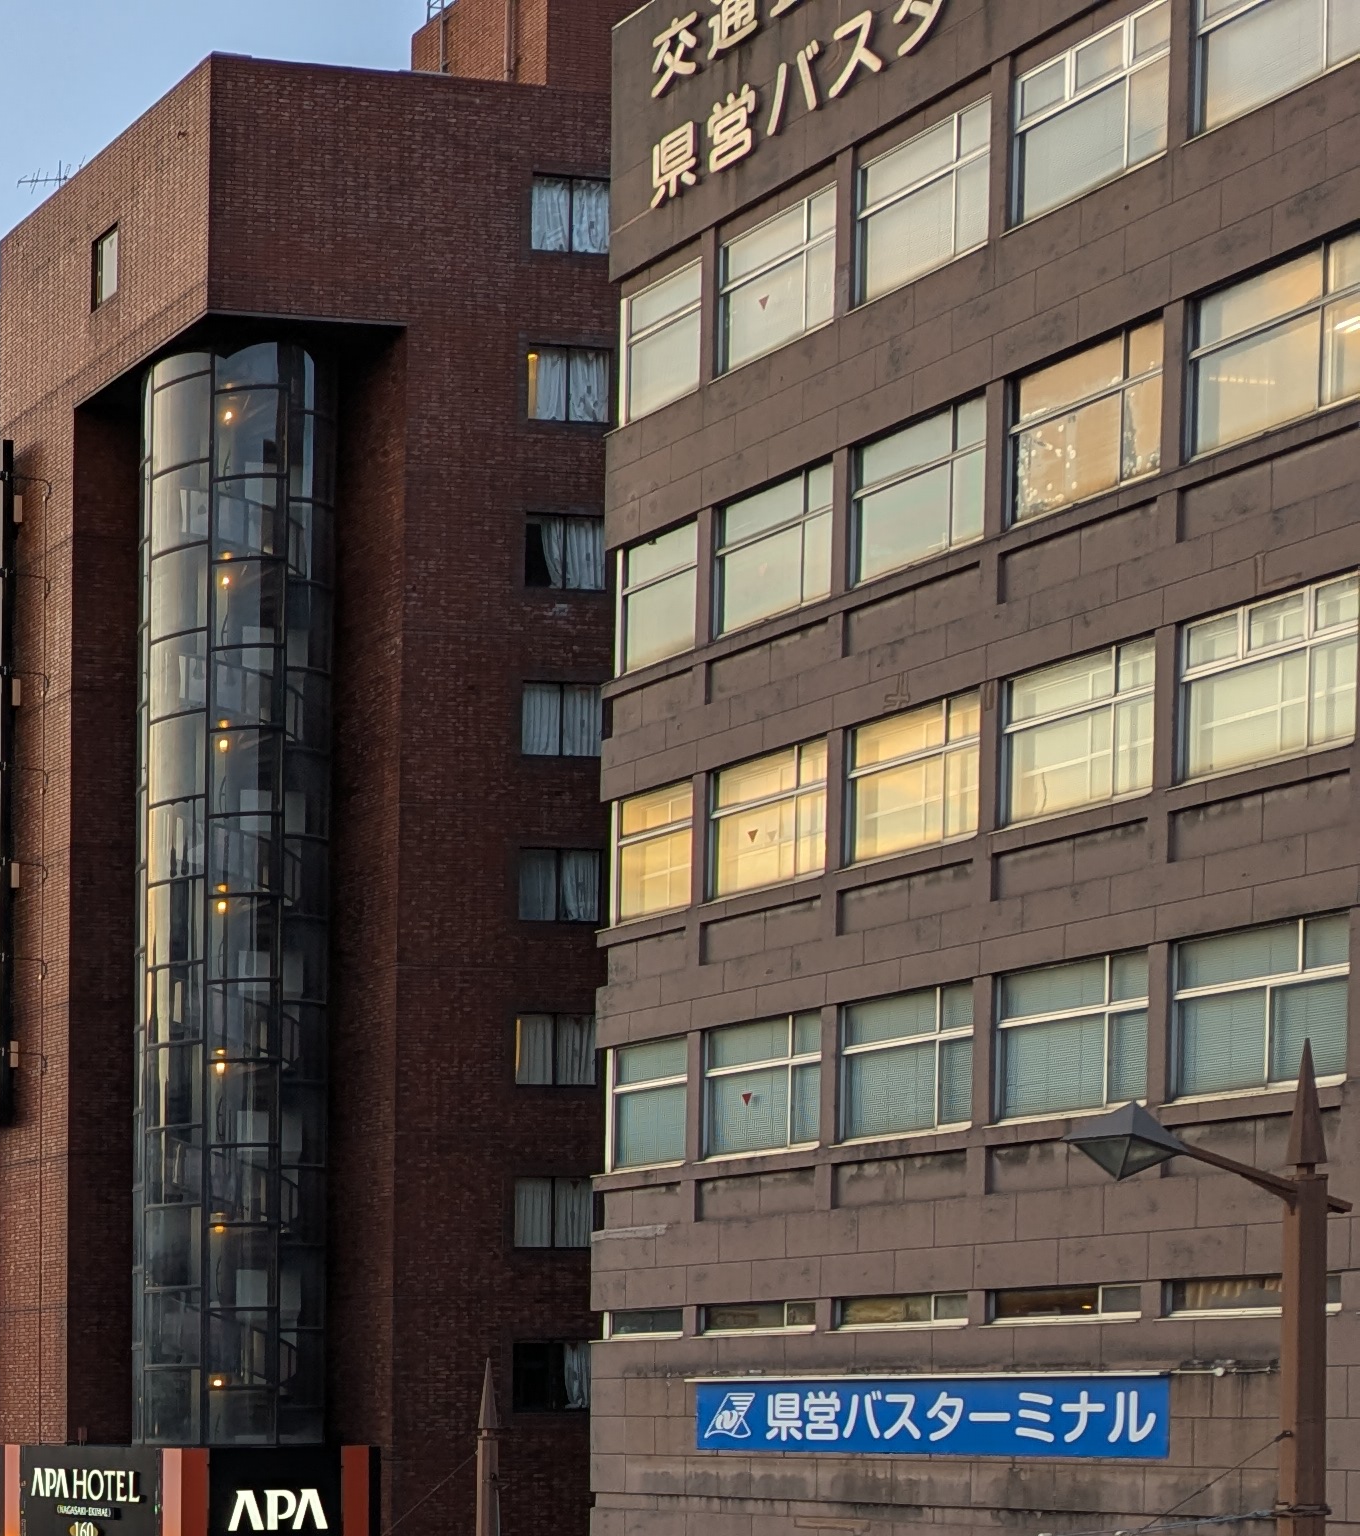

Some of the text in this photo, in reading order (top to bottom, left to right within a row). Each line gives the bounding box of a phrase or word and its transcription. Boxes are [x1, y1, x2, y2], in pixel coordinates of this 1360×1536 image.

[651, 0, 800, 98] 交通
[765, 1390, 1158, 1444] 県営バスターミナル
[30, 1468, 141, 1503] APA HOTEL
[227, 1488, 329, 1532] APA
